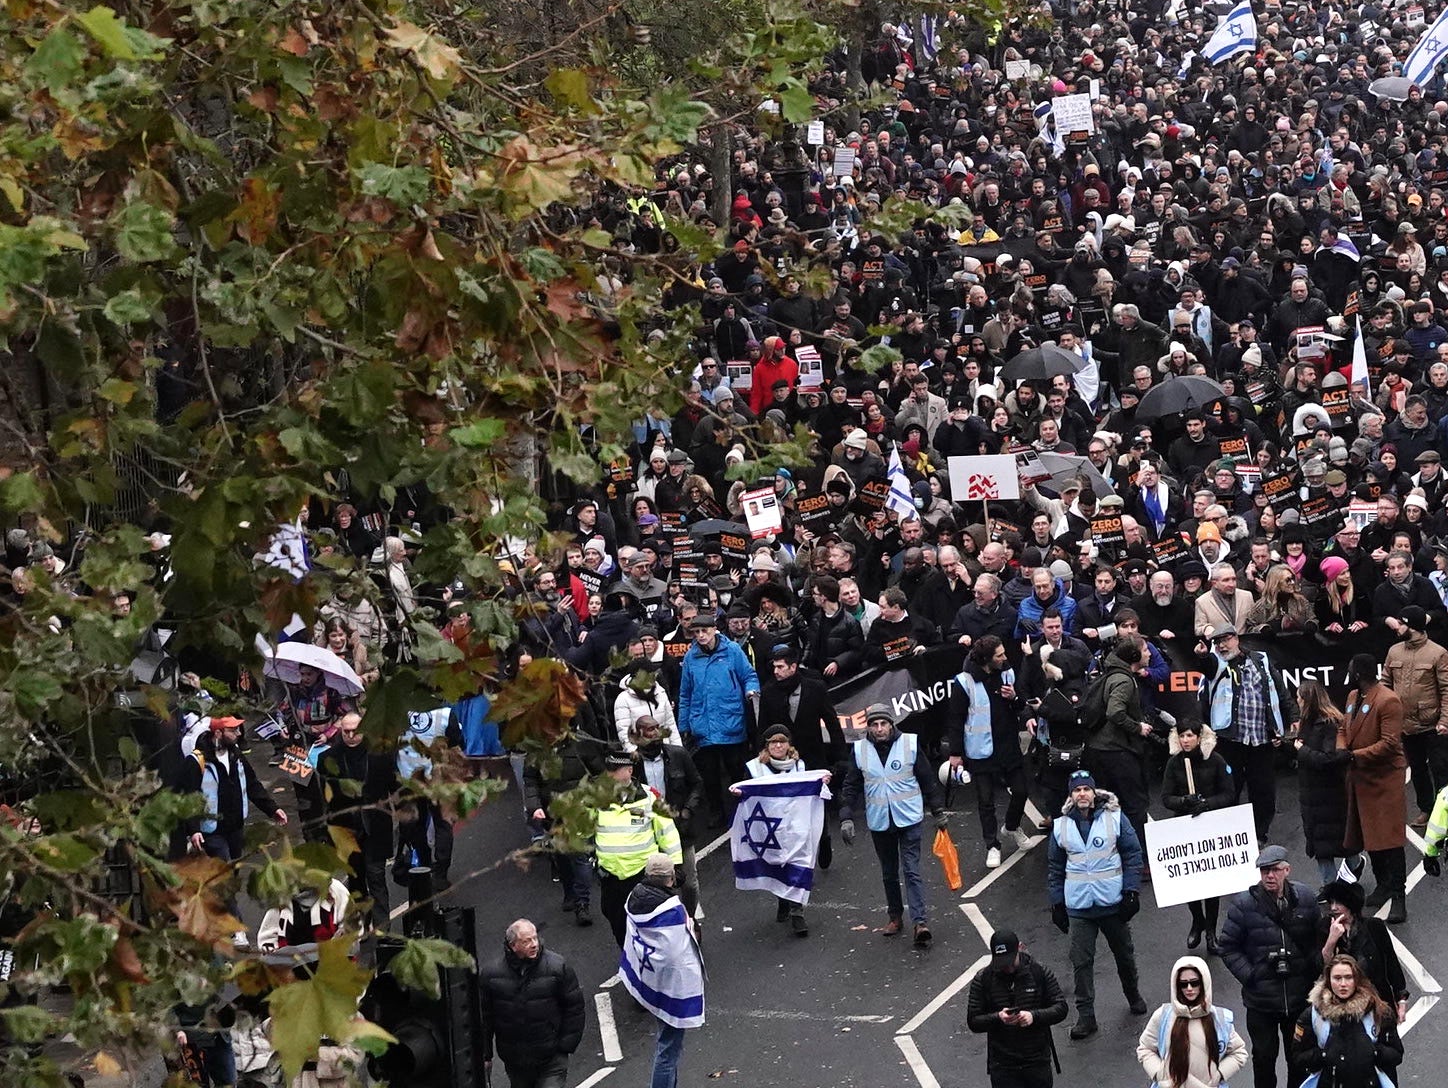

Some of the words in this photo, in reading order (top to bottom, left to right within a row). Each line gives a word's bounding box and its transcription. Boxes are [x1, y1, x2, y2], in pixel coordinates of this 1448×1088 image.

[1323, 391, 1347, 402] ACT
[1219, 438, 1245, 450] ZERO
[862, 481, 889, 494] ACT
[1262, 476, 1289, 492] ZERO
[797, 495, 827, 510] ZERO
[1091, 518, 1121, 530] ZERO
[721, 535, 746, 547] ZERO
[1094, 535, 1124, 544] ANTISEMITES
[1176, 550, 1188, 559] JEWS
[579, 572, 602, 587] NEVER
[583, 580, 600, 593] GAIN
[279, 758, 312, 778] ACT
[1218, 836, 1233, 849] WE
[1235, 833, 1248, 846] DO
[1158, 843, 1194, 861] LAUGH?
[1198, 839, 1215, 854] NOT
[1219, 854, 1237, 867] YOU
[1241, 851, 1248, 864] IF
[1165, 864, 1181, 878] US,
[1183, 857, 1216, 875] TICKLE
[1, 950, 13, 981] AGAIN
